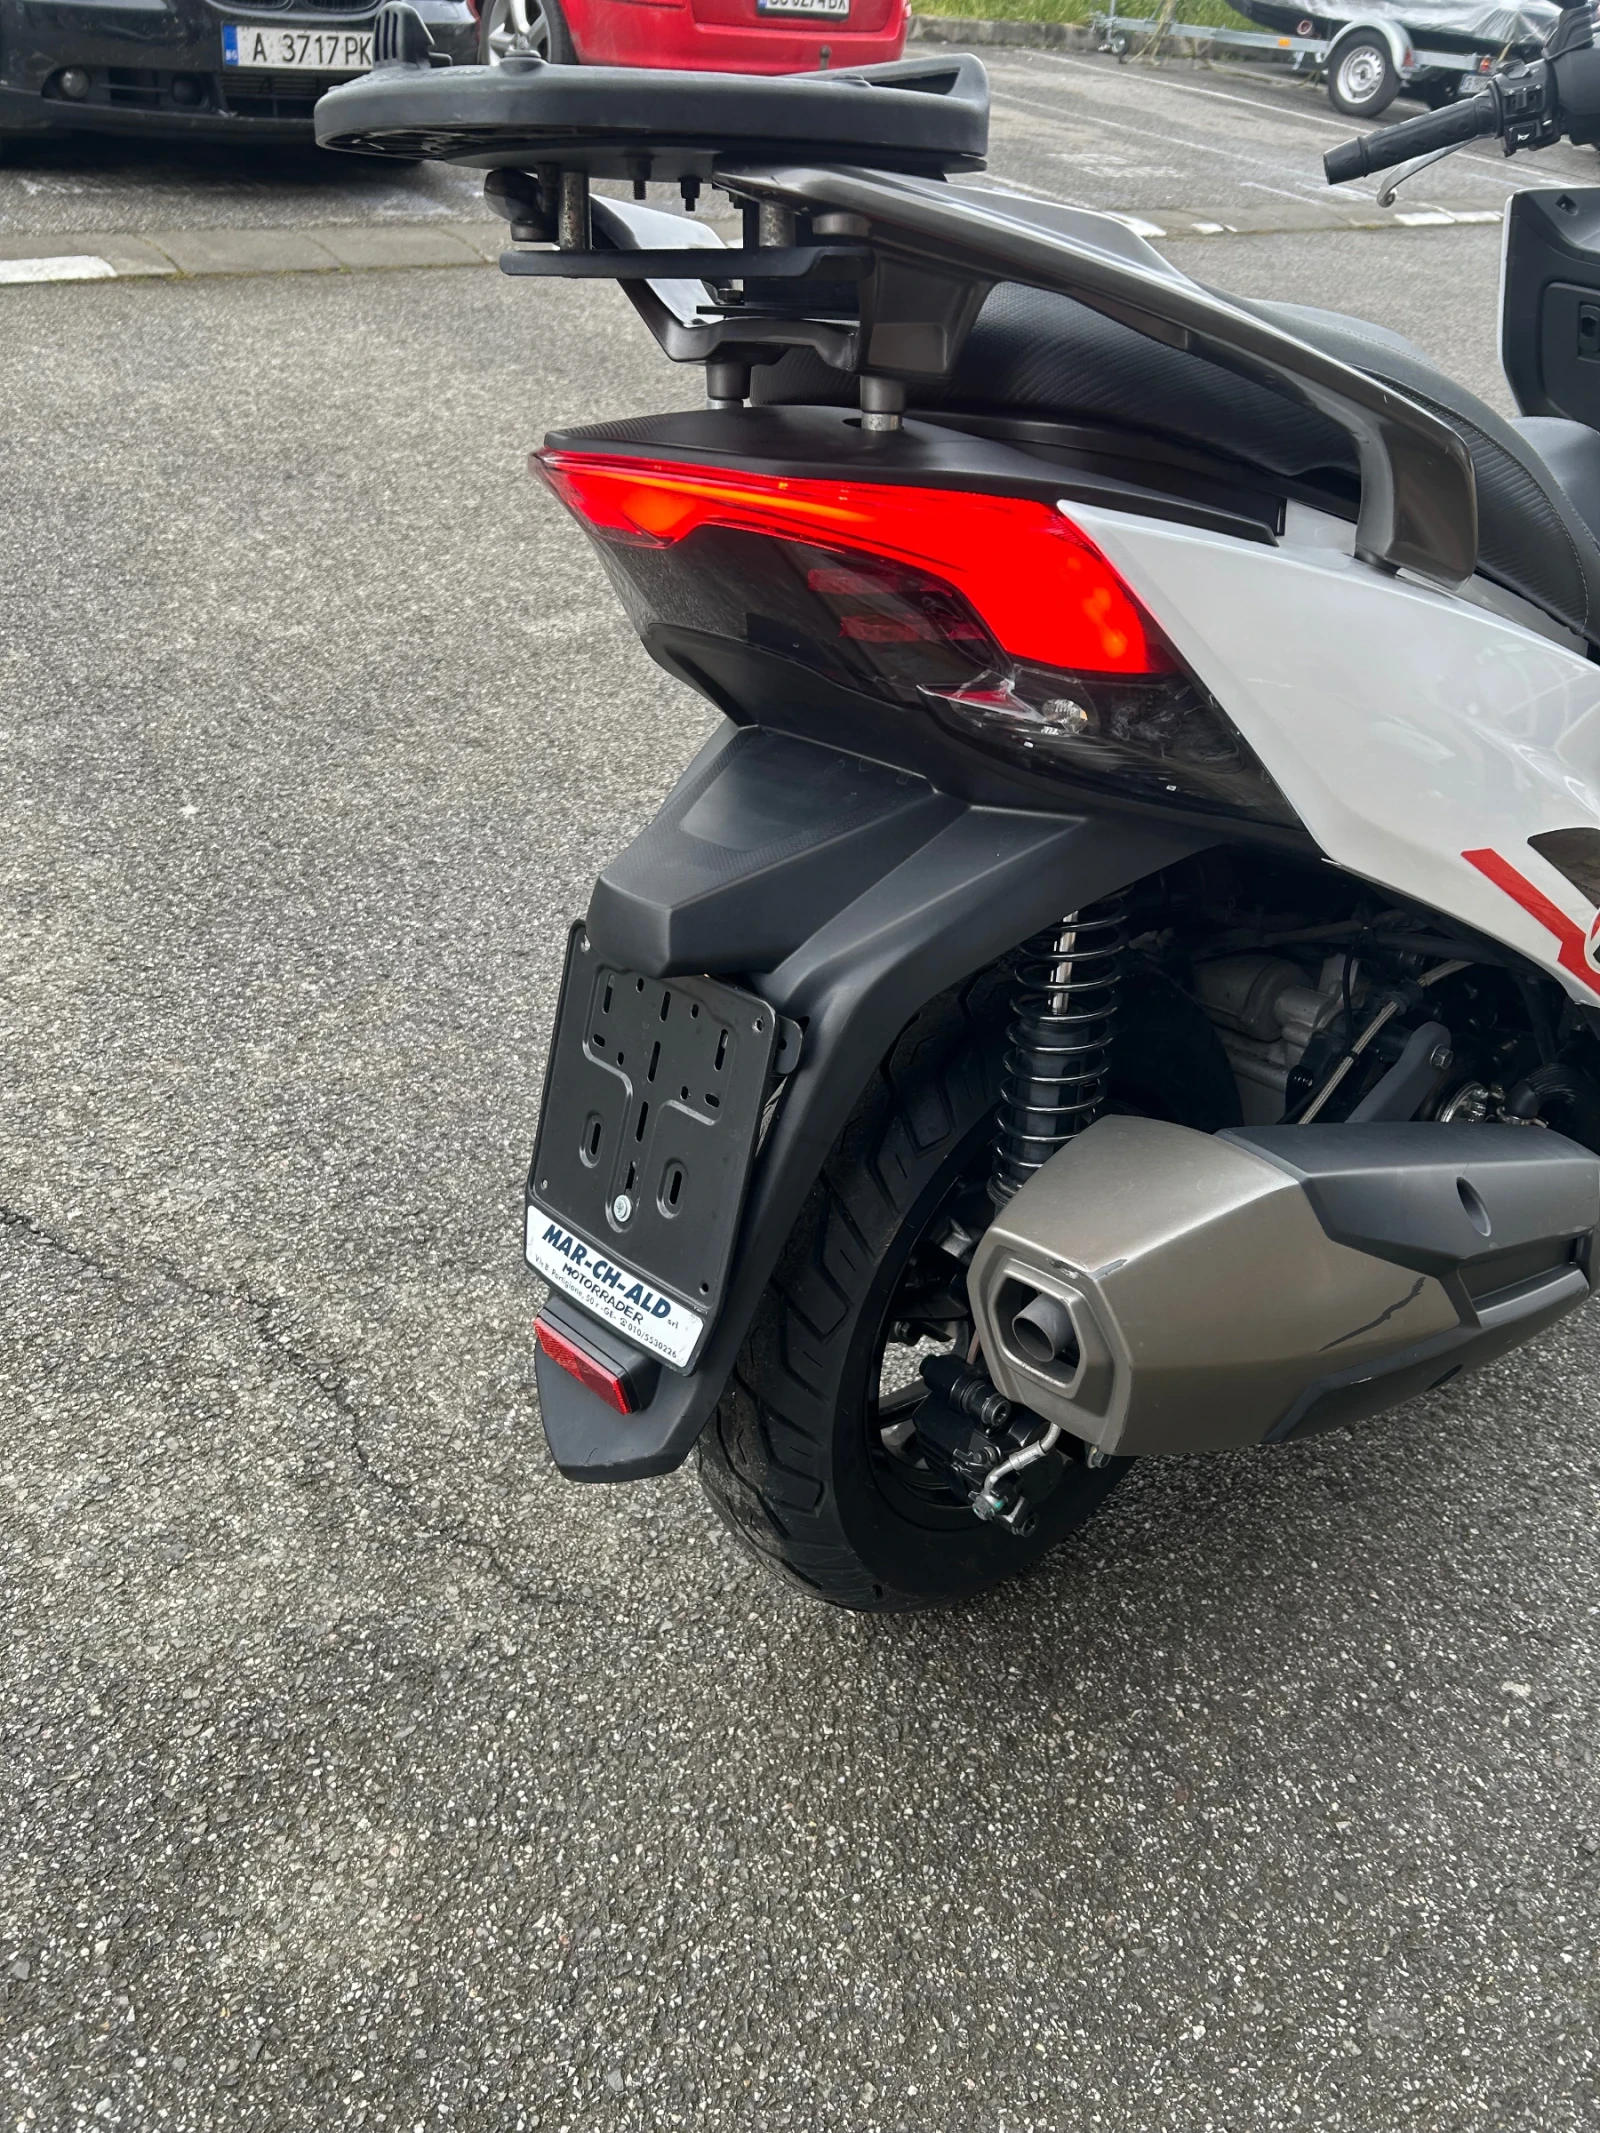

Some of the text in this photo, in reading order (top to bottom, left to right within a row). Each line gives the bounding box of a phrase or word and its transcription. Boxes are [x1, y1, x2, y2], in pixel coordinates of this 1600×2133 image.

[541, 1224, 679, 1329] MAR-CH-ALD srl
[562, 1262, 644, 1325] MOTORRADER
[585, 1295, 595, 1306] 50
